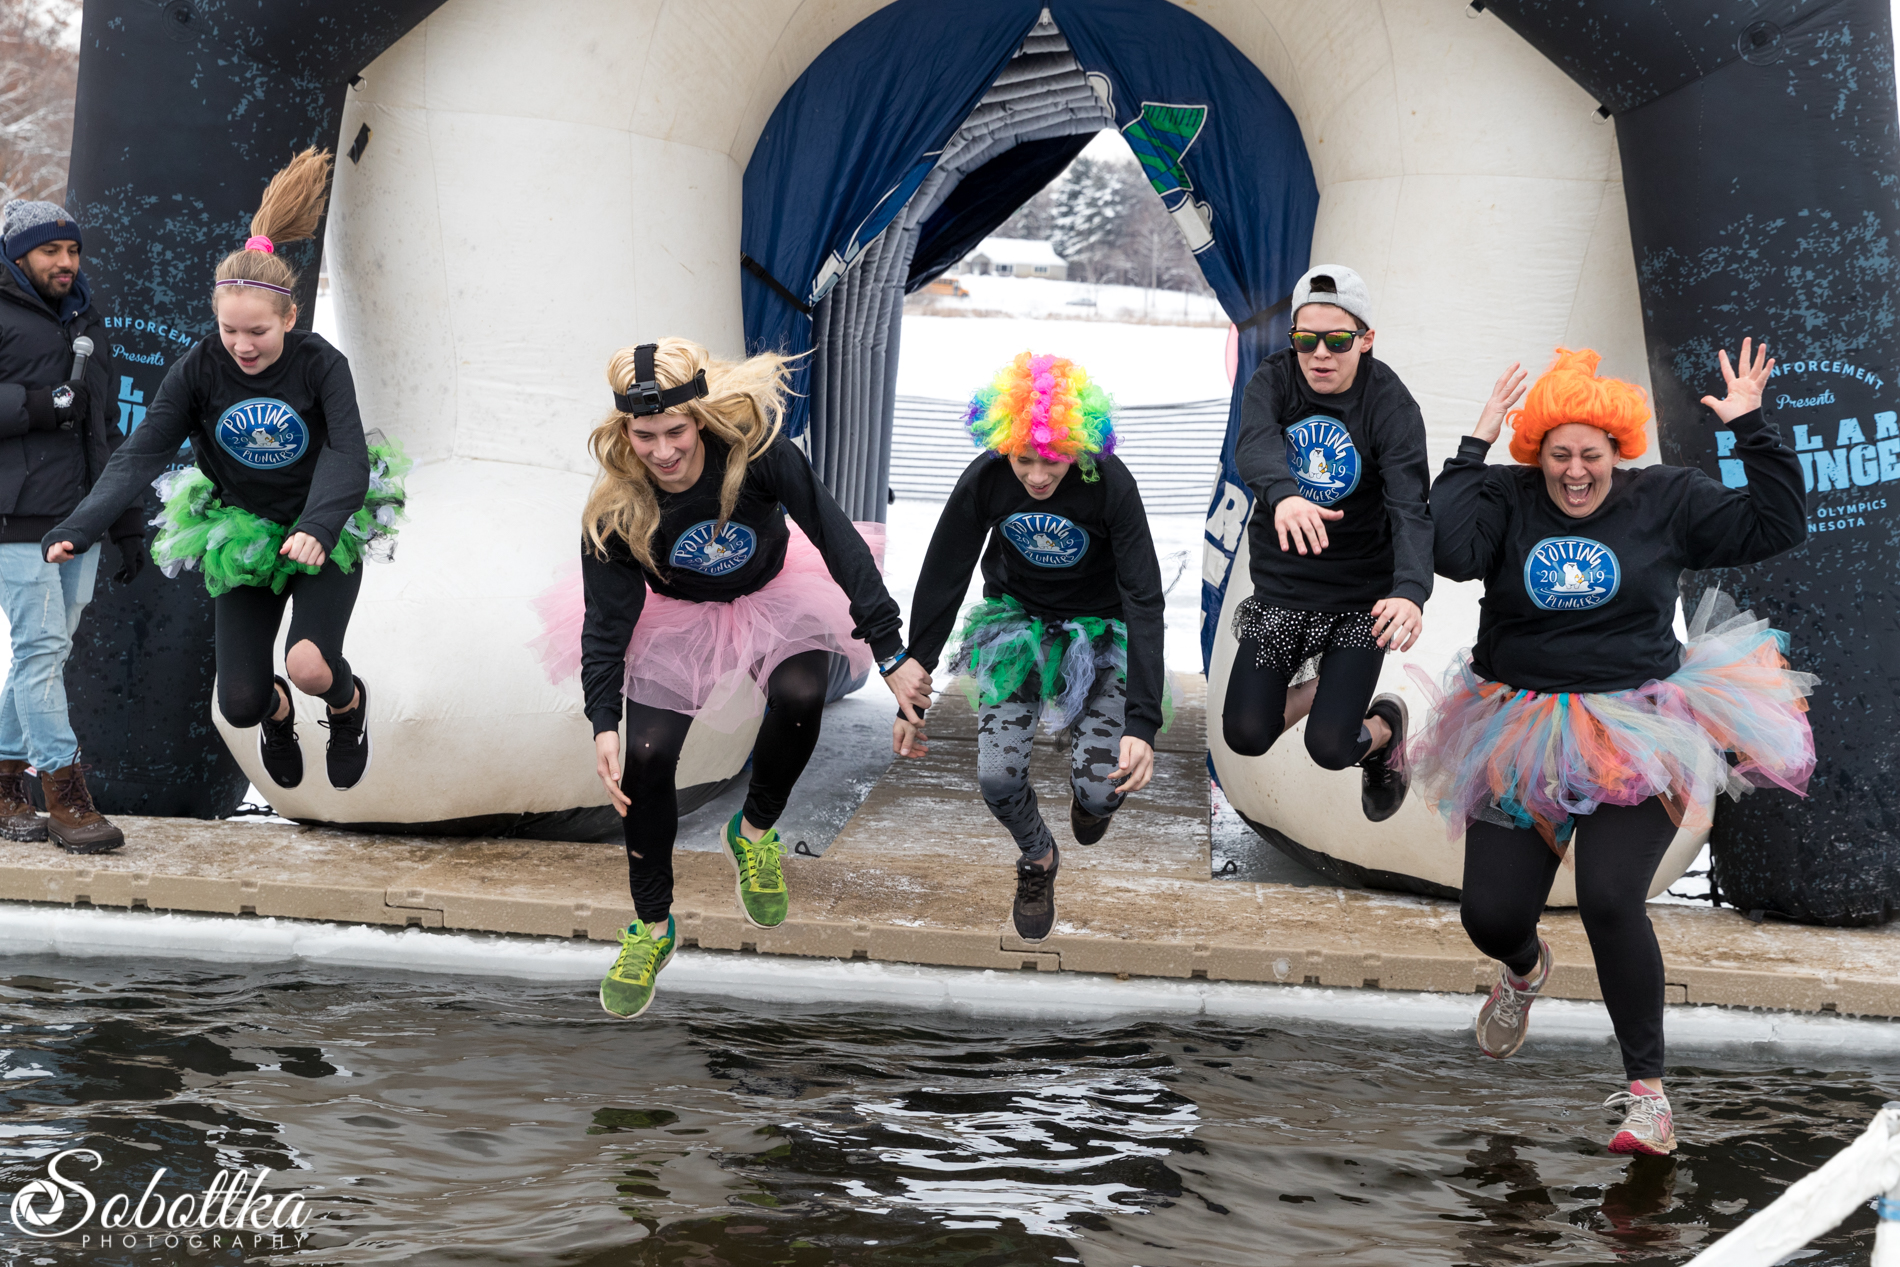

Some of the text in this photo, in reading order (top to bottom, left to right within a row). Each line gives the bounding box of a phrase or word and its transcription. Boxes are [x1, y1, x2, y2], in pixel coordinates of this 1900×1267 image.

[104, 316, 199, 349] ENFORCEM
[111, 344, 165, 367] Presents
[1770, 360, 1884, 390] NFORCEMENT
[1775, 388, 1836, 410] Presents
[222, 403, 294, 435] POTTING
[231, 432, 294, 445] 20 19
[1286, 421, 1355, 461] POTTING
[1714, 410, 1900, 457] PLAR
[242, 449, 294, 464] PLUNGERS
[1332, 463, 1346, 477] 19
[1816, 498, 1888, 519] OLYMPICS
[1807, 516, 1866, 533] NESOTA
[729, 540, 744, 551] 19
[1059, 538, 1074, 548] 19
[1534, 542, 1607, 569] POTTING
[1539, 569, 1605, 584] 20 19
[1544, 594, 1600, 609] PLUNGERS
